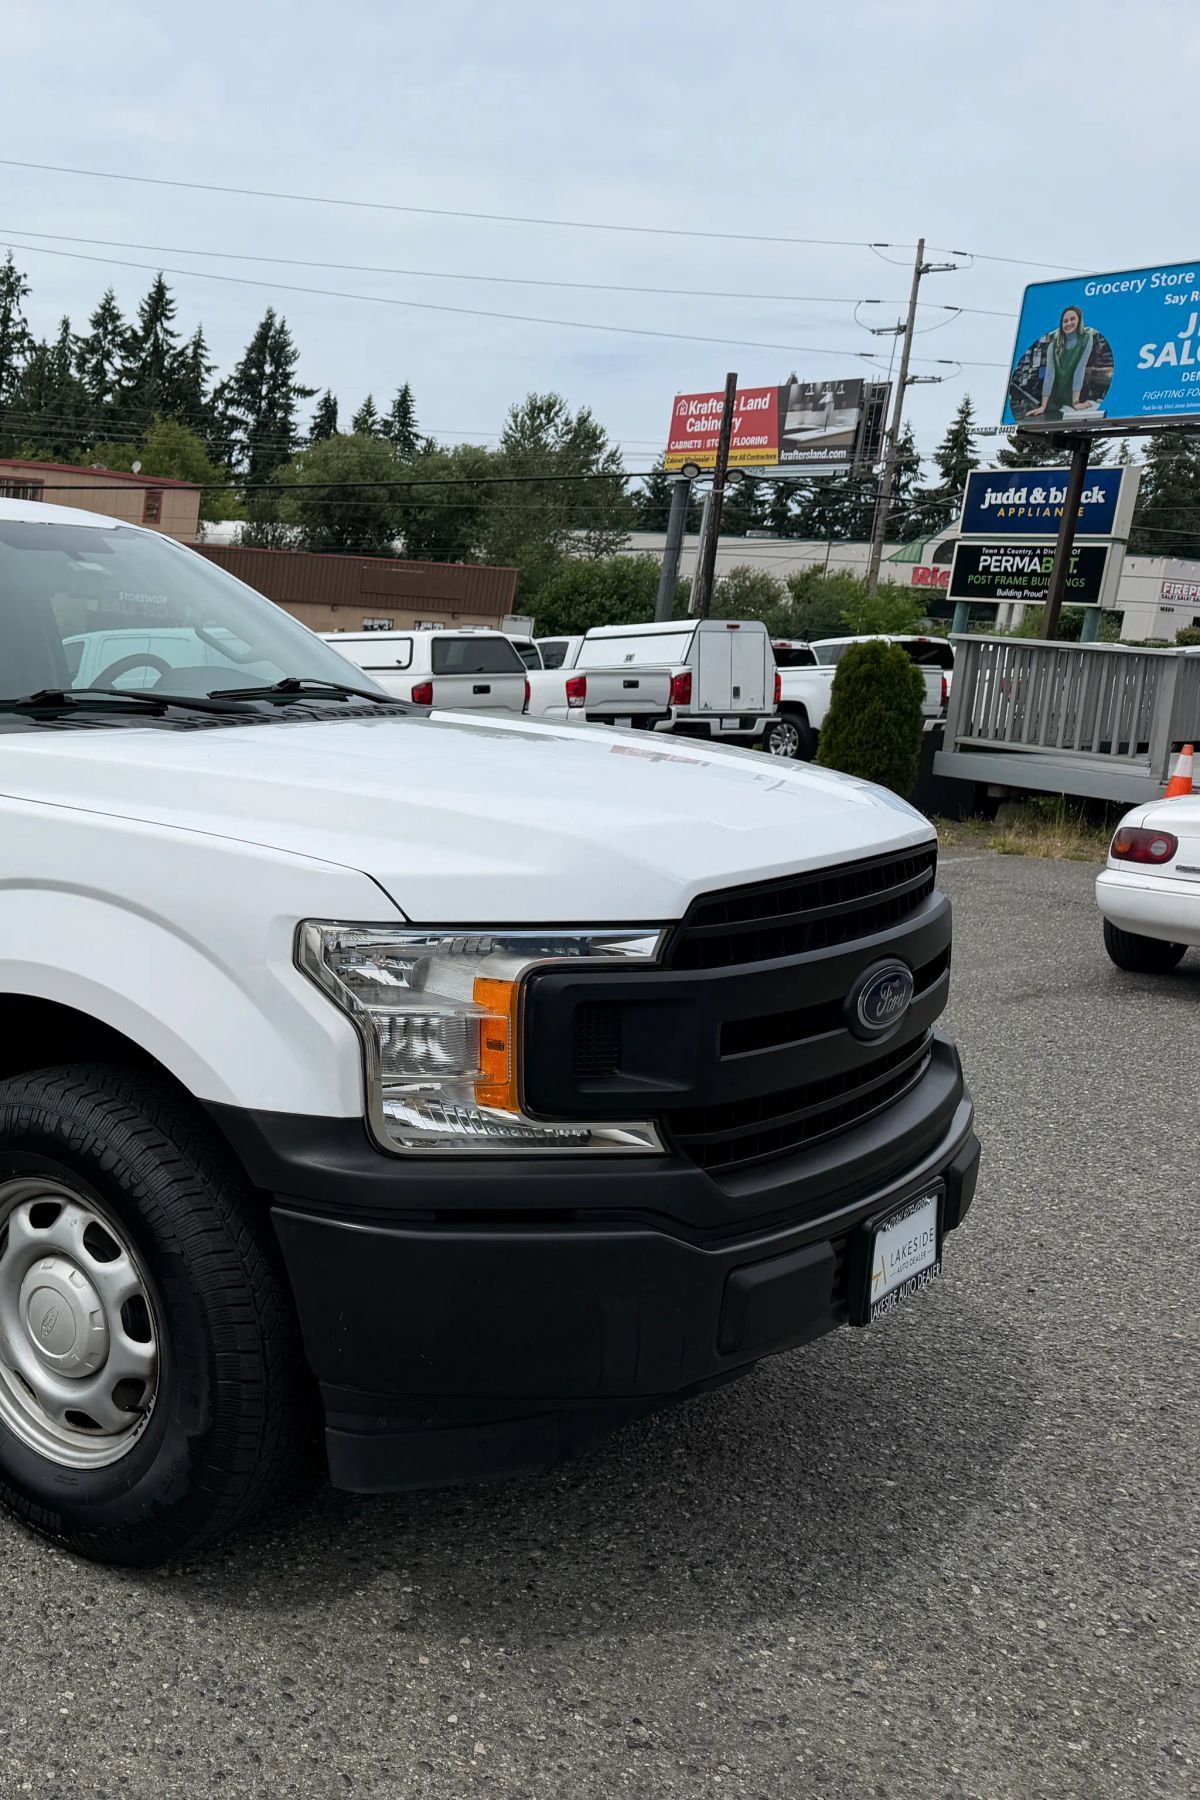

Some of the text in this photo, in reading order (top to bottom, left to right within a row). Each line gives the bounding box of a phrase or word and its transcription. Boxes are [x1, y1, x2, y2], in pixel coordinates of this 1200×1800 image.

[1084, 272, 1195, 297] Grocery Store
[1164, 293, 1188, 305] Say
[1137, 340, 1200, 369] SAL
[1142, 387, 1200, 400] FIGHTING FO
[688, 393, 771, 415] Kraftes Land
[670, 436, 768, 449] CABINETS STO FLOORING
[780, 448, 847, 461] kraftersland.com
[980, 485, 1106, 509] judd & blck
[997, 506, 1085, 518] APPLIANE
[1006, 548, 1034, 556] Country,
[911, 566, 951, 586] Ric
[968, 575, 1086, 588] POST FRAME BUILNGS
[996, 588, 1022, 599] Building
[876, 979, 907, 1017] Ford
[890, 1227, 934, 1267] LAKESIDE
[896, 1250, 927, 1275] AUTO DEALER
[870, 1263, 941, 1321] LAKESIDE AUTO DEALER
